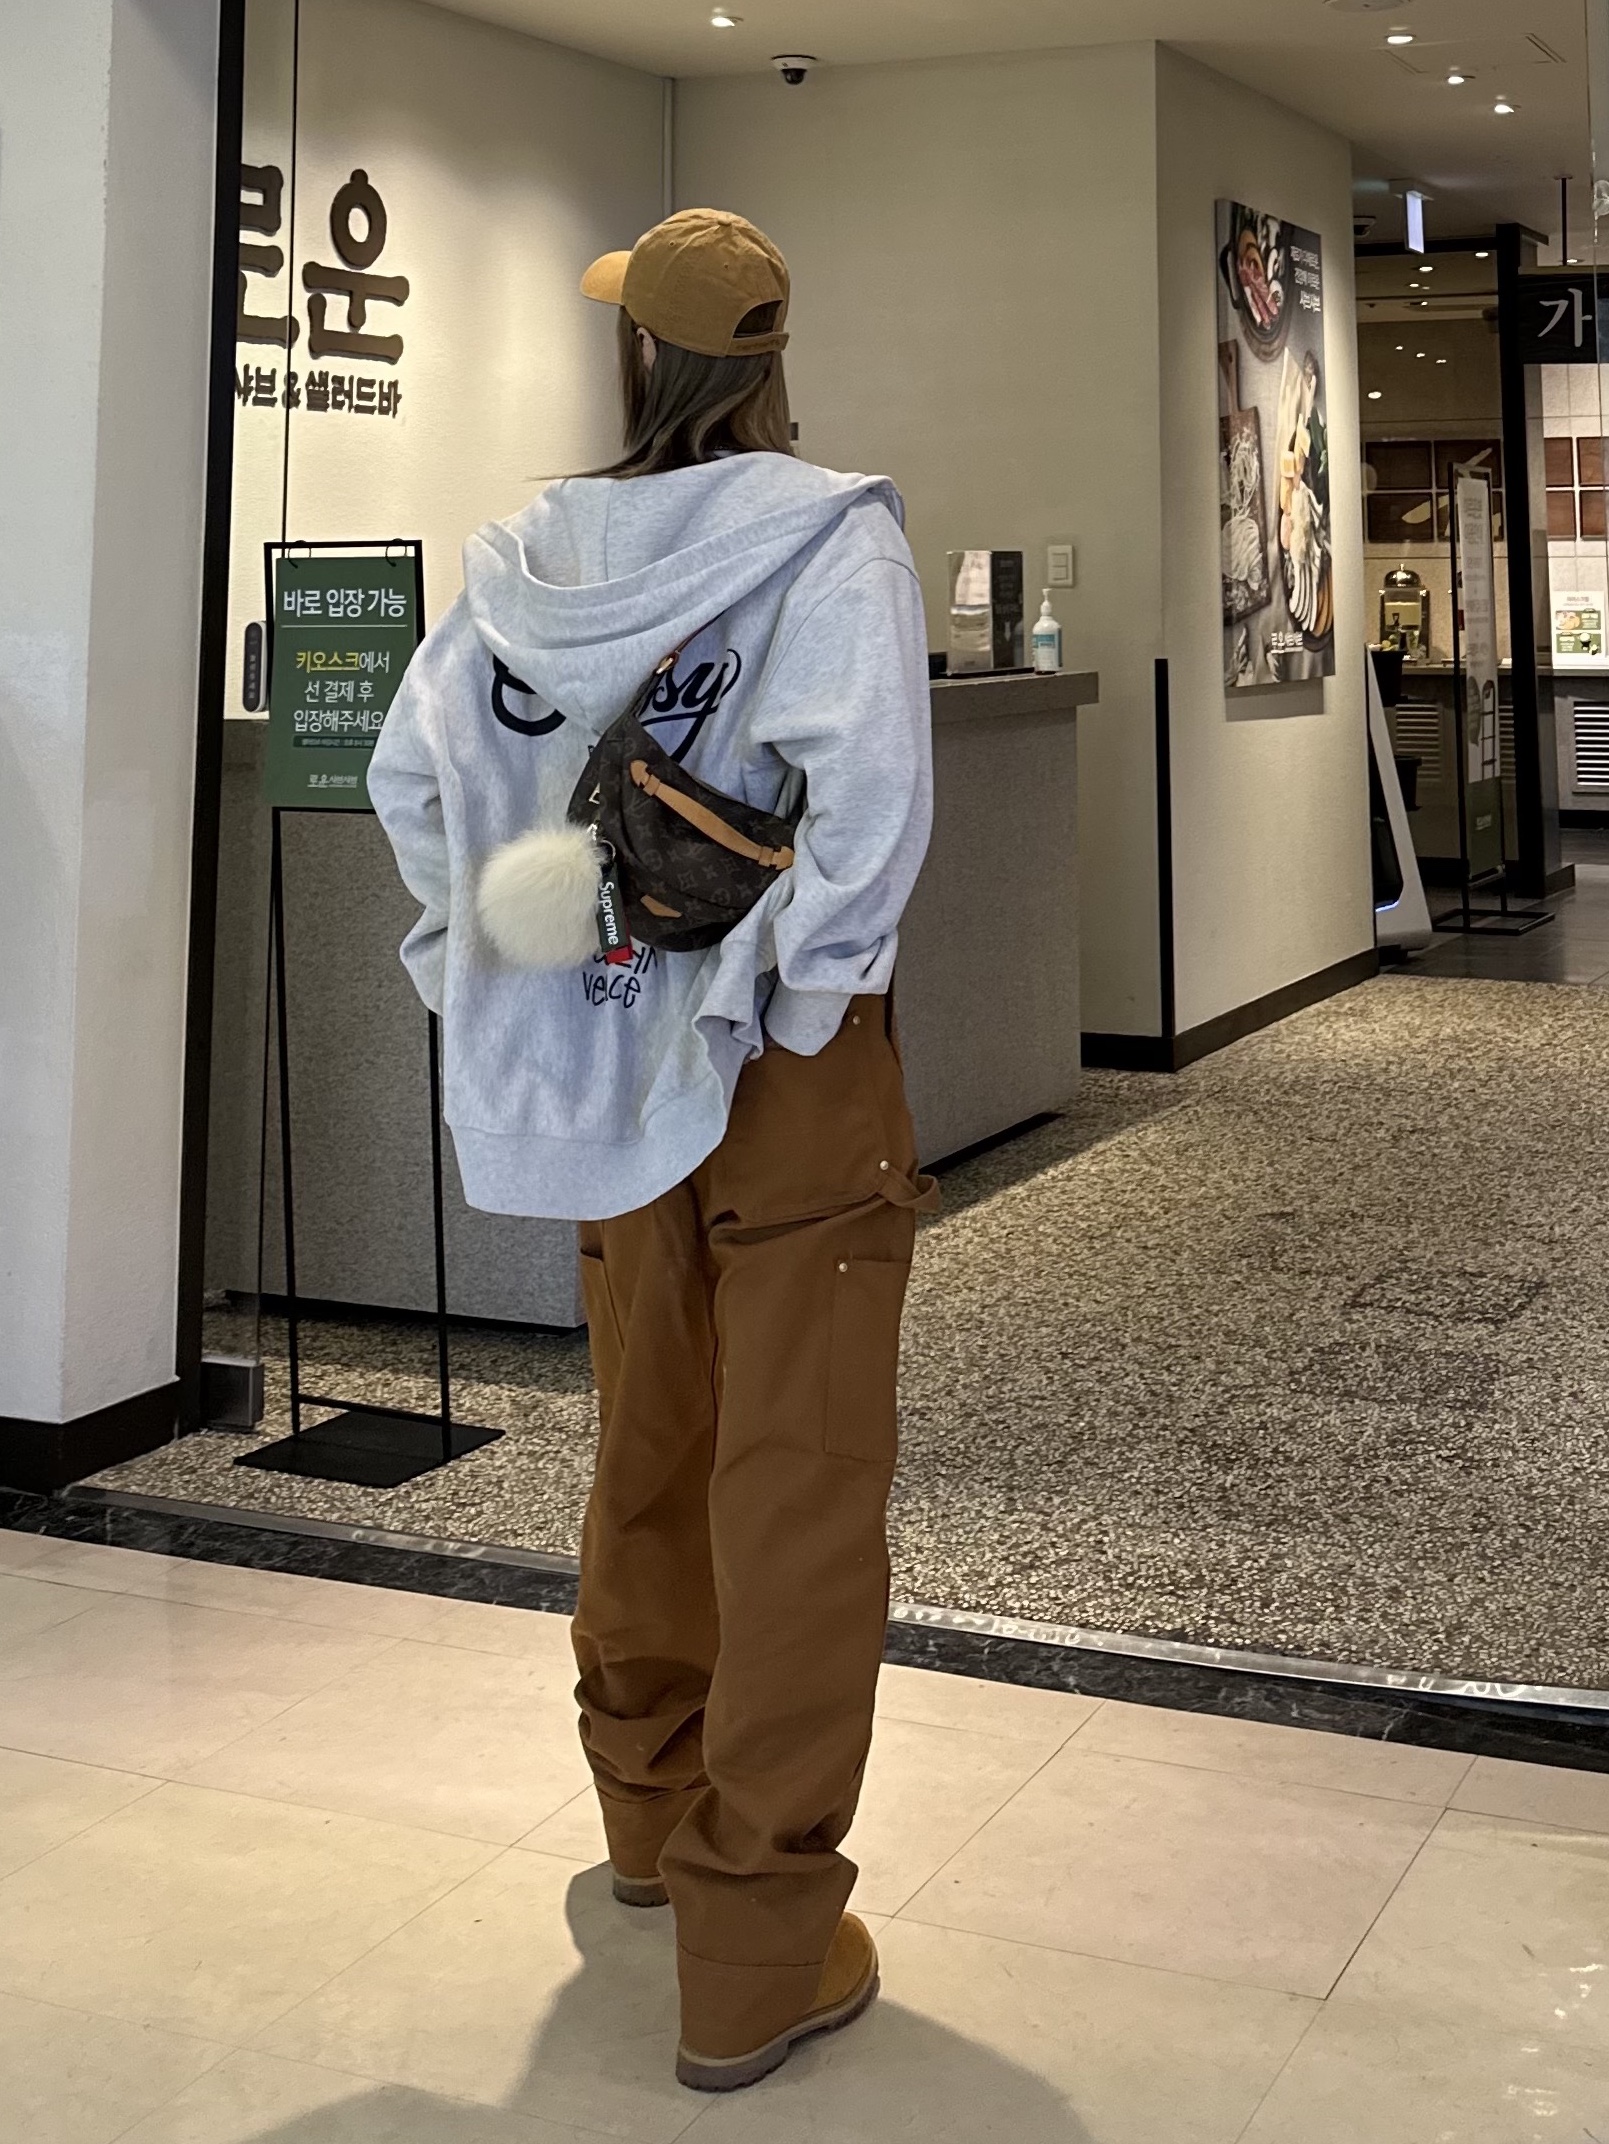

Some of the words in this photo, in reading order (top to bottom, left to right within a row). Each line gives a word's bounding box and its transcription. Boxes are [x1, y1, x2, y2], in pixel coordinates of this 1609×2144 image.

[1537, 287, 1592, 347] 가
[284, 589, 322, 617] 바로
[326, 588, 365, 617] 입장
[367, 588, 407, 617] 가능
[296, 651, 390, 673] 키오스크에서
[304, 680, 320, 702] 선
[324, 680, 355, 702] 결제
[357, 680, 374, 702] 후
[293, 710, 384, 732] 입장해주세요
[600, 881, 619, 945] Supreme
